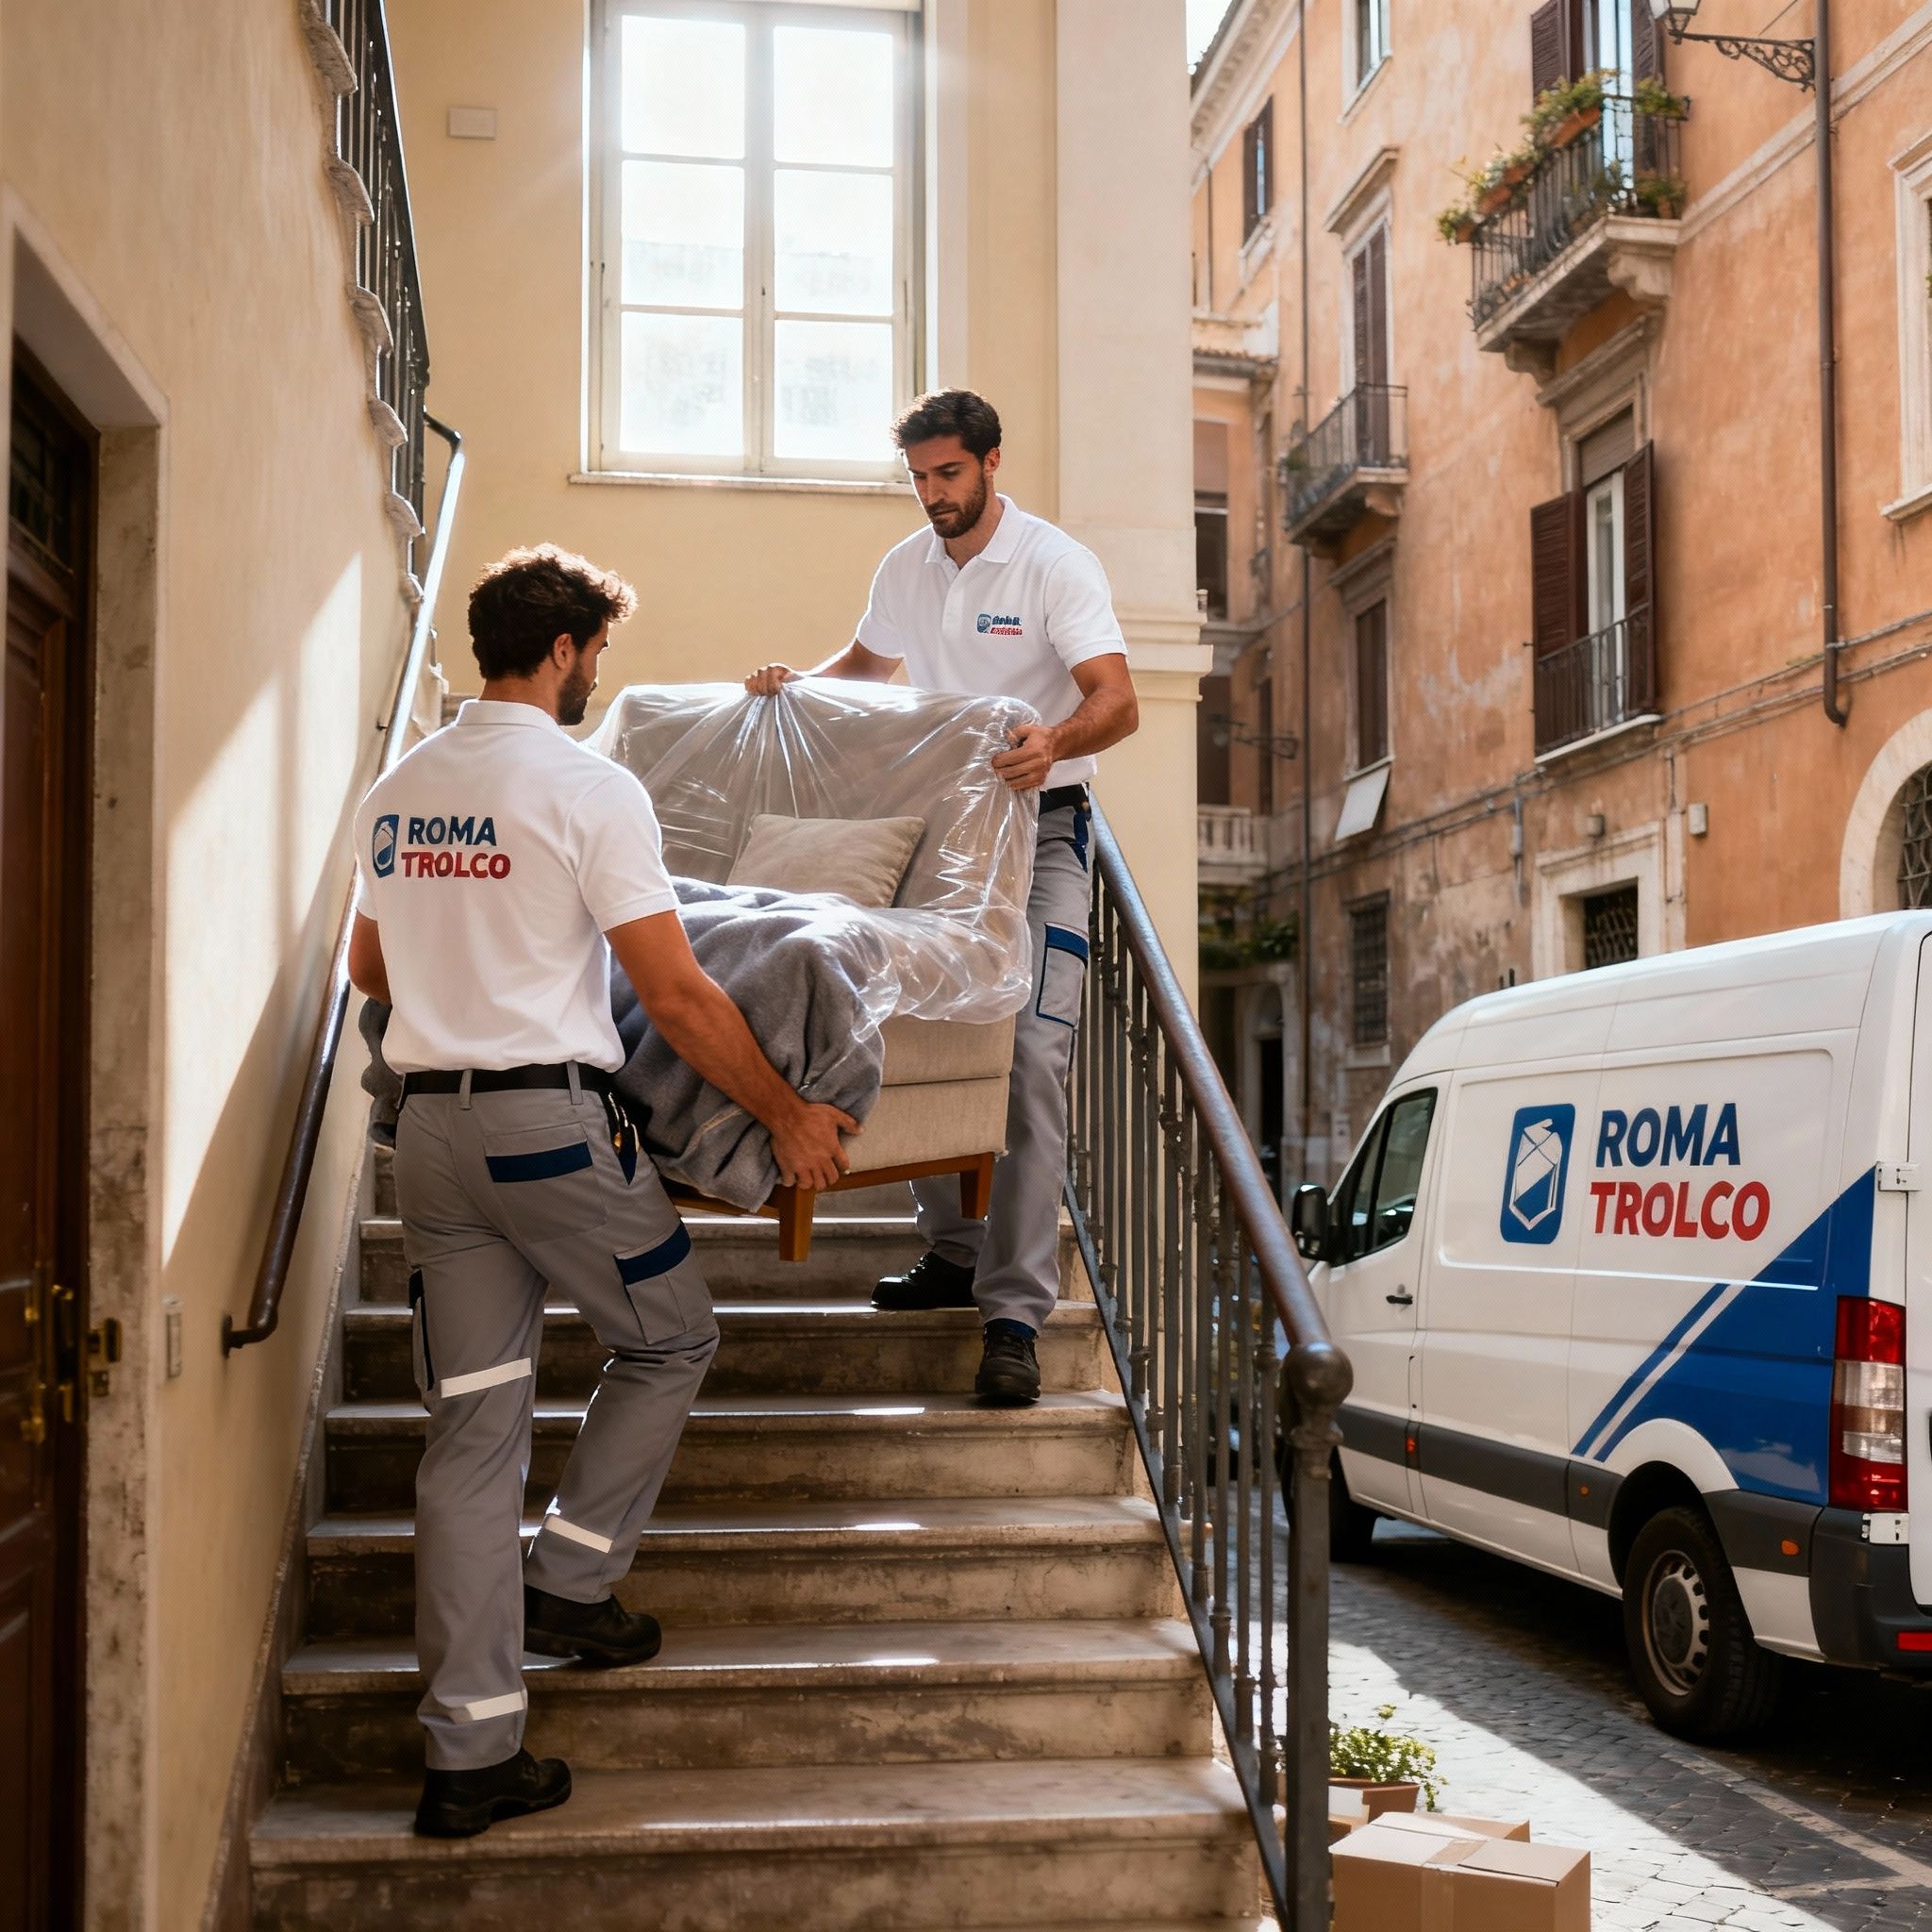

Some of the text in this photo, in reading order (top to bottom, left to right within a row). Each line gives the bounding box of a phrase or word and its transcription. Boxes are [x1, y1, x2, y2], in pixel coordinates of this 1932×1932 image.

[408, 815, 497, 846] ROMA
[401, 851, 511, 879] TROLCO
[1595, 1102, 1741, 1168] ROMA
[1590, 1180, 1771, 1241] TROLCO
